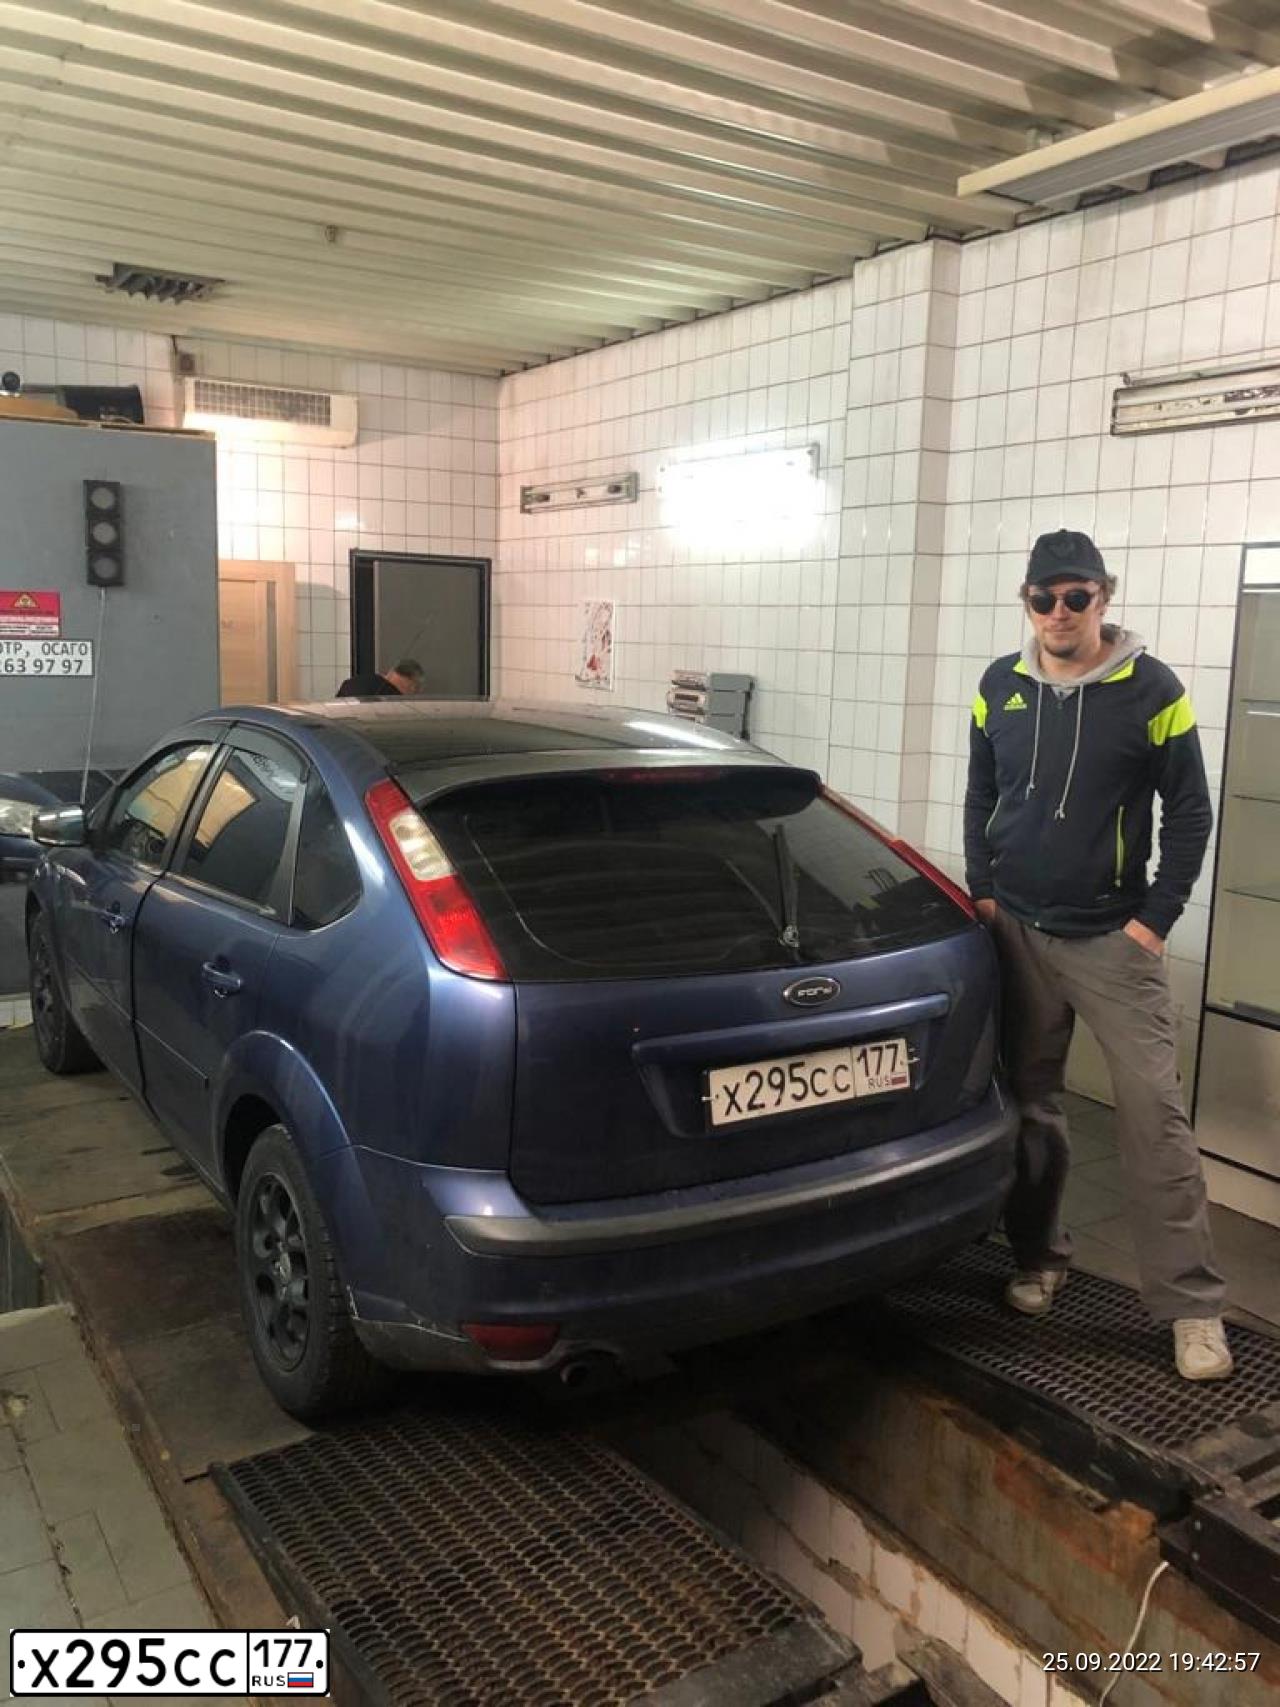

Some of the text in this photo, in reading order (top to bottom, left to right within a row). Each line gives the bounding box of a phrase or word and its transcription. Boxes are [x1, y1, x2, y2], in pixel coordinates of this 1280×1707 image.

[41, 641, 88, 656] ОСАГО
[0, 658, 83, 673] 63 97 97
[722, 1043, 899, 1116] Х295СС 177
[867, 1077, 890, 1089] RUS
